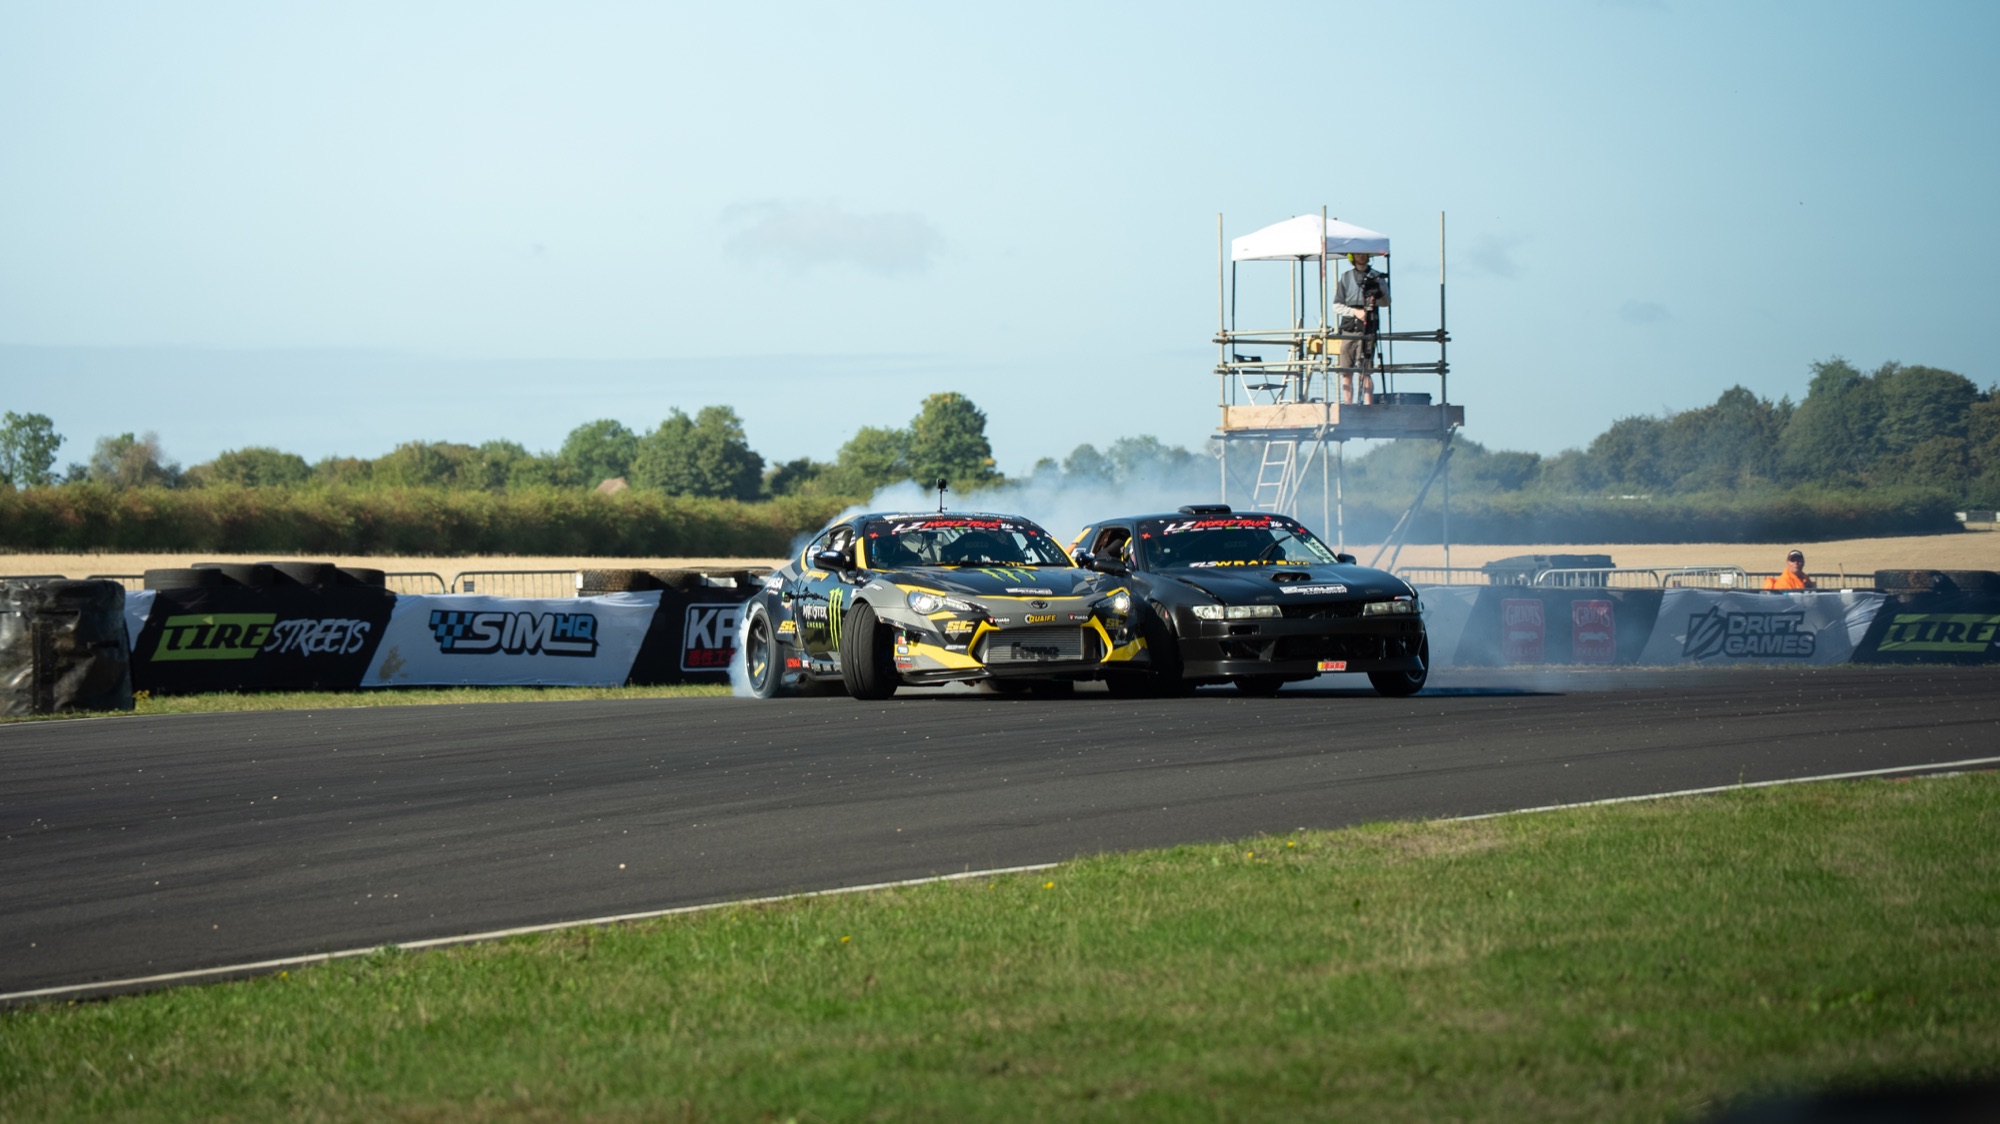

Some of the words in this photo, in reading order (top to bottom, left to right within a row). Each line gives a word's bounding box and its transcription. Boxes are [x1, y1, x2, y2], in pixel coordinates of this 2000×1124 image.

[922, 520, 968, 529] WORLD
[966, 520, 1001, 529] TOUR
[1193, 519, 1237, 529] WORLD
[1236, 519, 1270, 527] TOUR
[1028, 614, 1056, 623] QUAIFE
[1727, 614, 1803, 634] DRIFT
[161, 620, 273, 653] TIRE
[264, 618, 371, 657] STREETS
[1888, 619, 1998, 645] TIRE
[1725, 635, 1814, 654] GAMES
